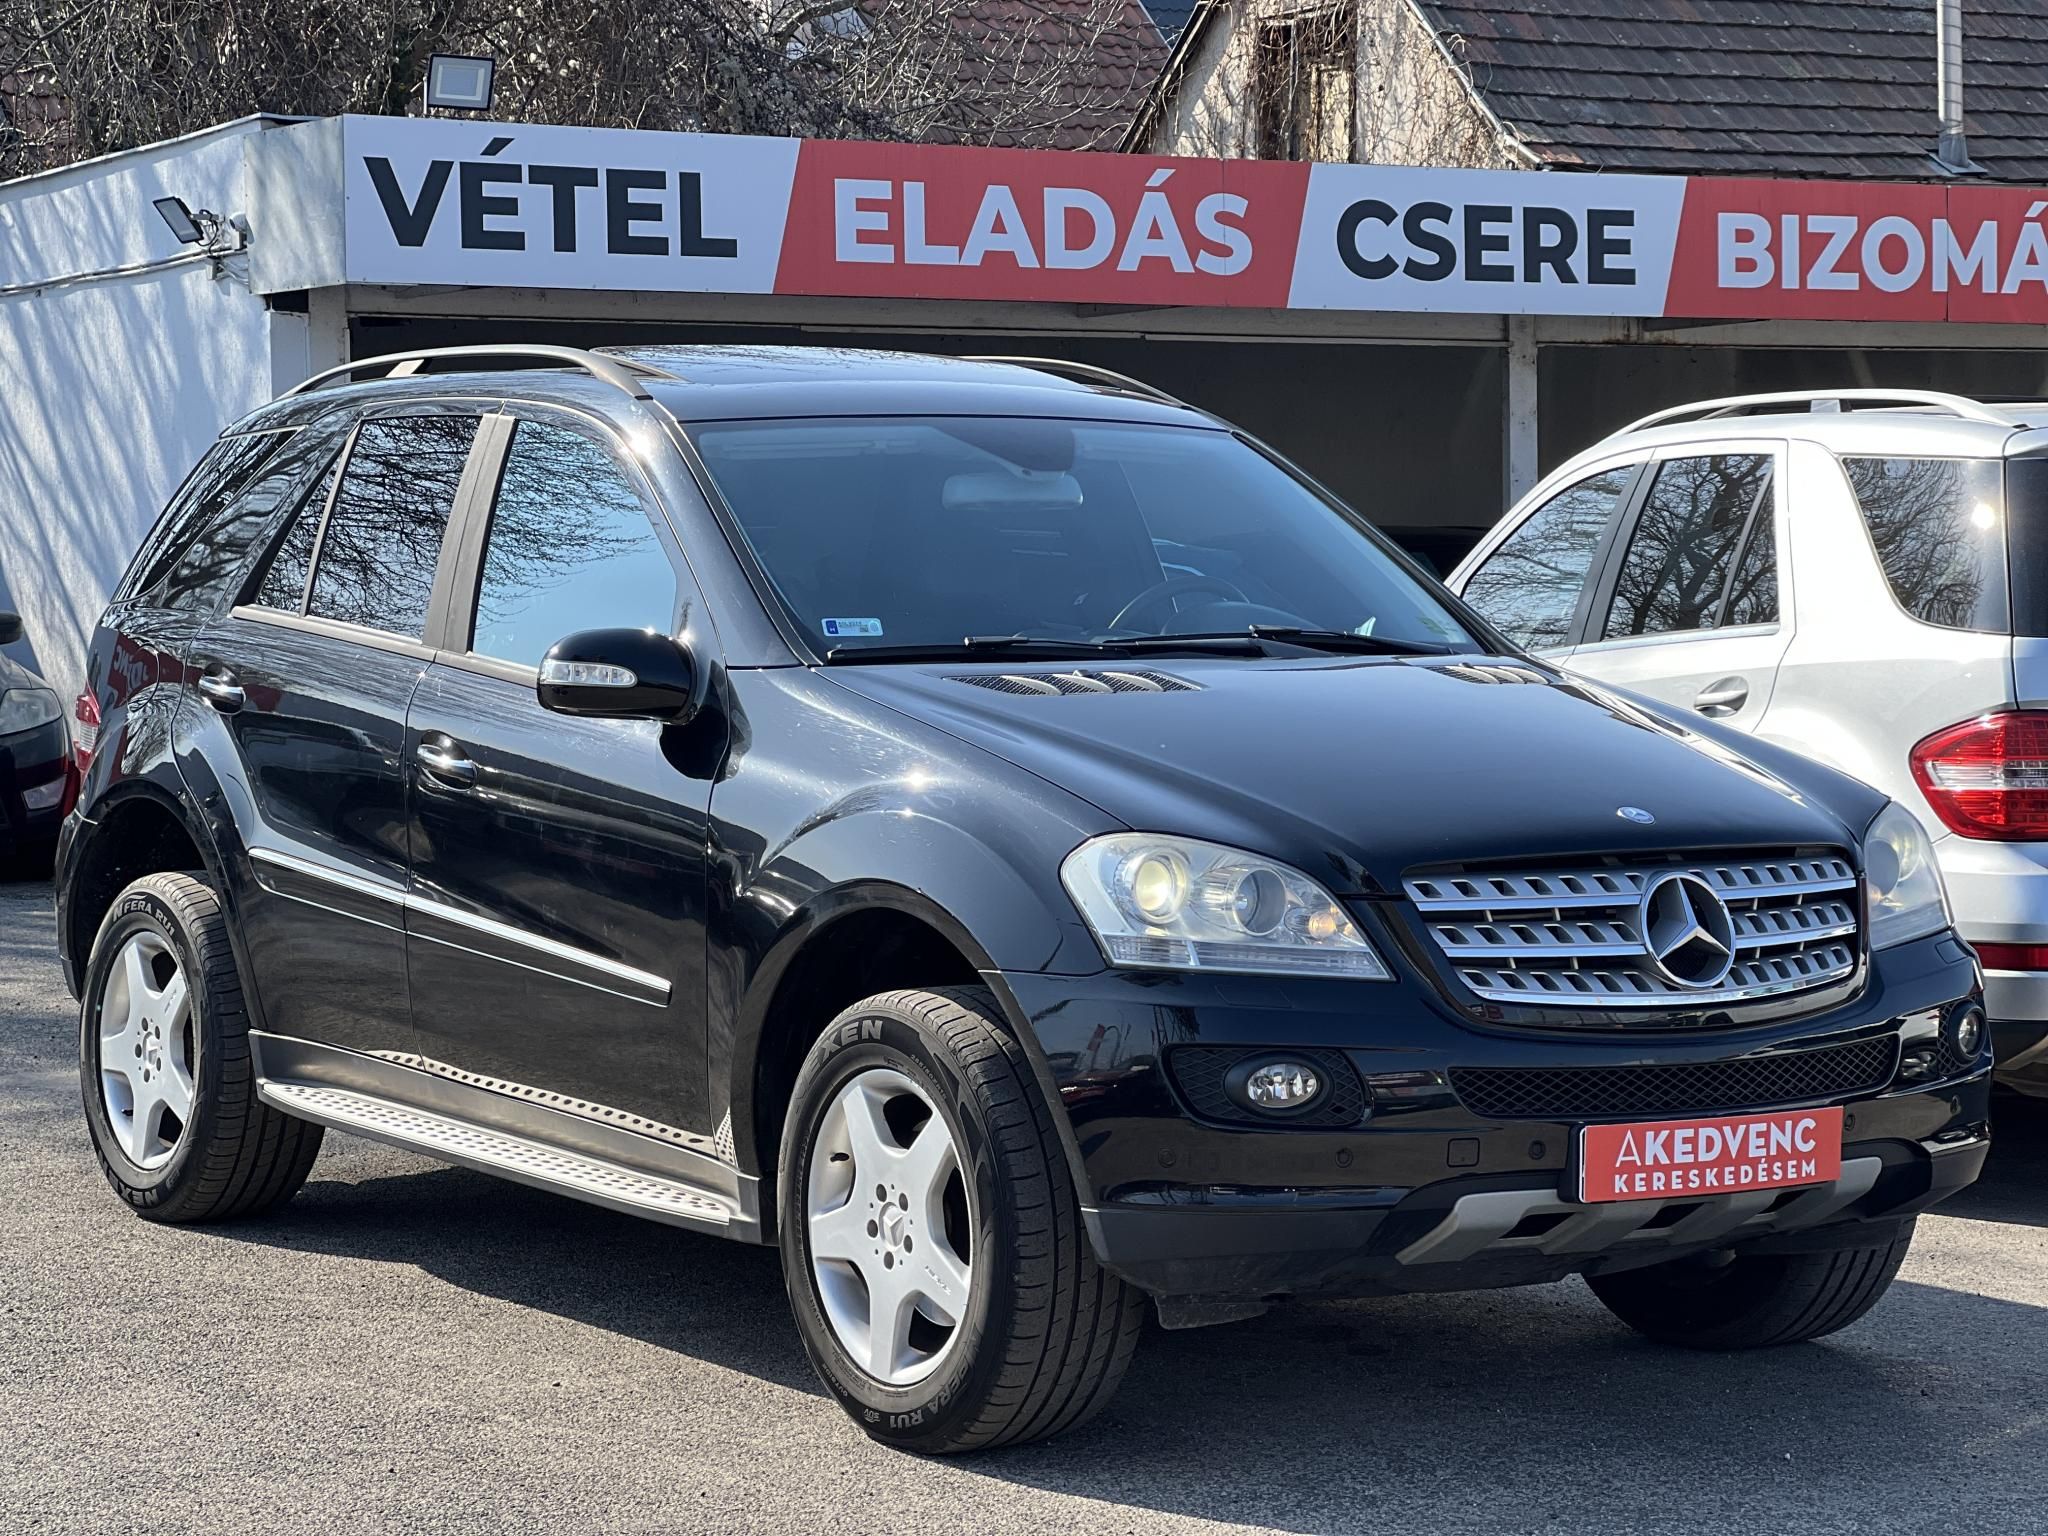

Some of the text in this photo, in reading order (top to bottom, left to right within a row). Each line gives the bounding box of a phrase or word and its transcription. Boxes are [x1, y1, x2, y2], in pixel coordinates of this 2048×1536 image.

[363, 137, 2048, 295] VÉTEL ELADÁS CSERE BIZOMÁ
[1614, 1157, 1816, 1193] KERESKEDÉSEM
